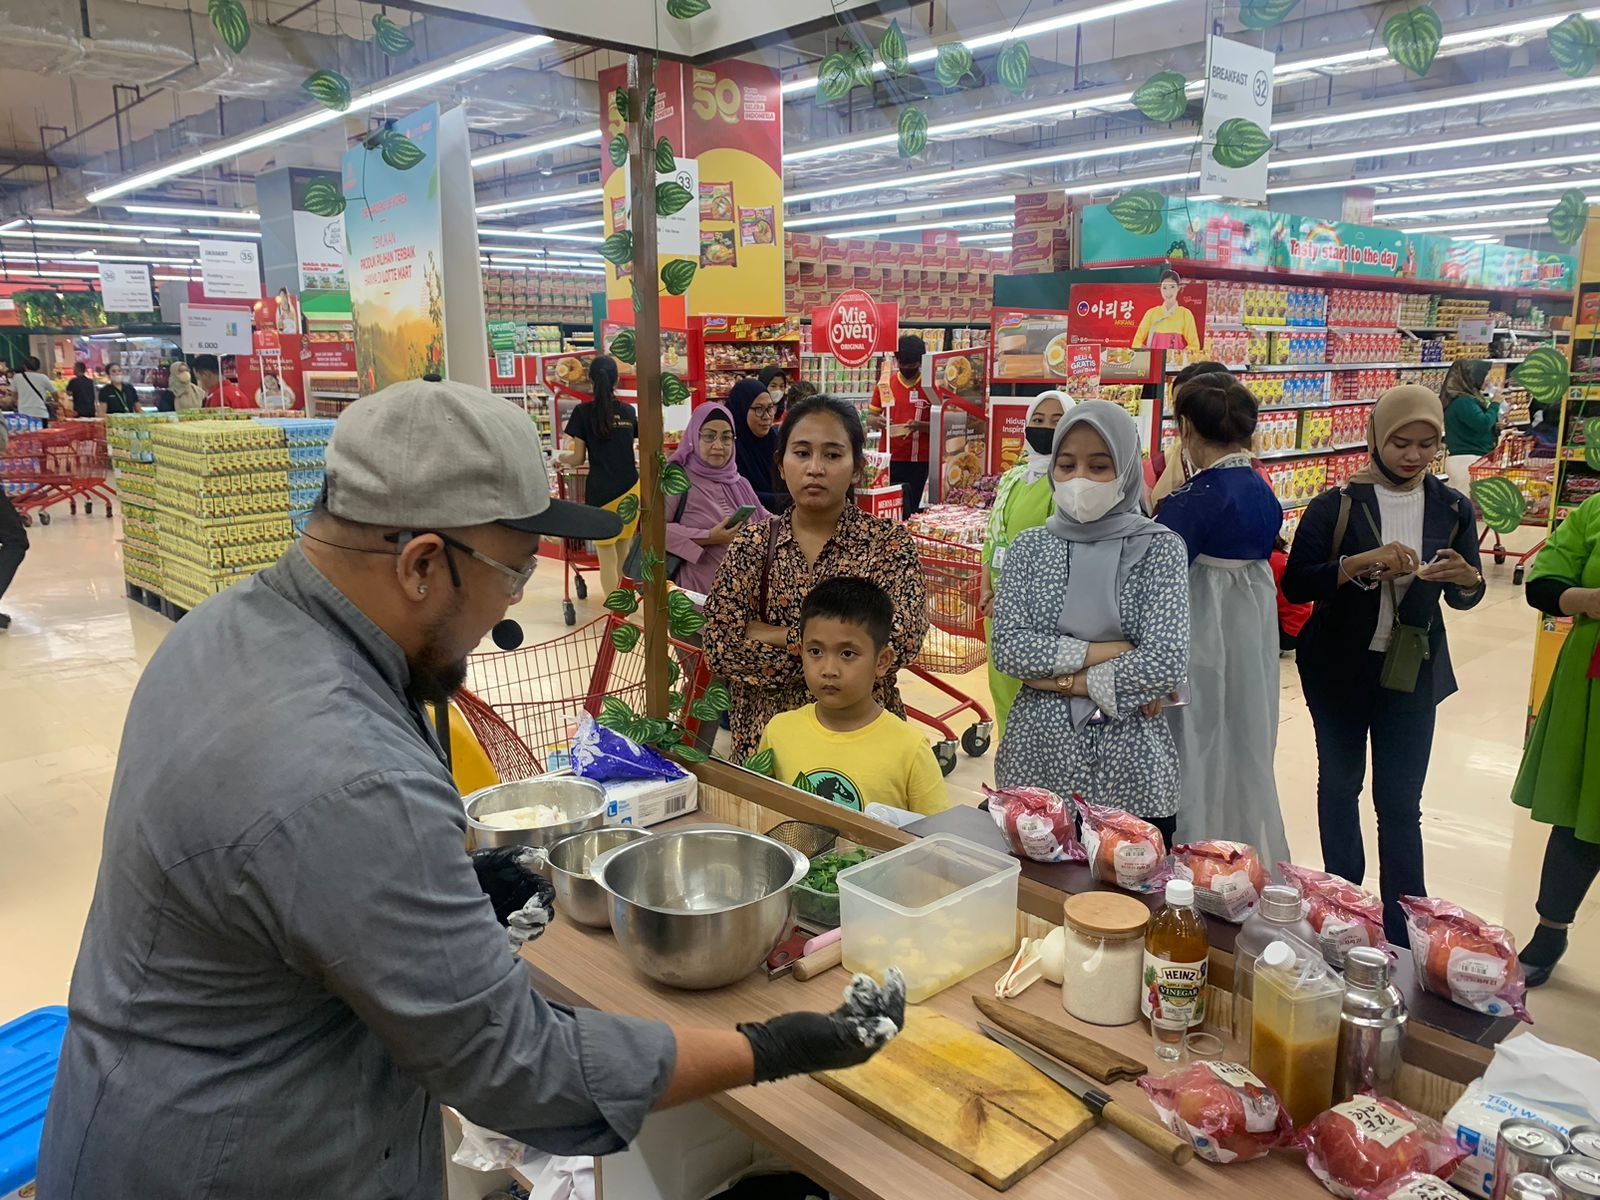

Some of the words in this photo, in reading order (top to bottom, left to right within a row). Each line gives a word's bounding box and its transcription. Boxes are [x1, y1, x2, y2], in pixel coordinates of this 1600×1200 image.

[1212, 65, 1248, 86] BREAKFAST
[1255, 78, 1267, 99] 32
[692, 79, 741, 124] 50
[678, 176, 691, 189] 33
[242, 252, 252, 261] 35
[1290, 239, 1319, 262] Tasty
[1320, 241, 1349, 260] start
[1351, 247, 1361, 262] to
[1363, 248, 1379, 264] the
[1381, 250, 1399, 270] day
[838, 305, 867, 324] Mie
[1091, 300, 1134, 320] 아리랑
[831, 323, 874, 344] Oven
[1071, 360, 1096, 370] GRATIS
[1006, 417, 1026, 426] Hidup
[1003, 425, 1024, 434] Inspira
[1165, 970, 1196, 981] HEINZ
[1160, 986, 1199, 997] VINEGAR
